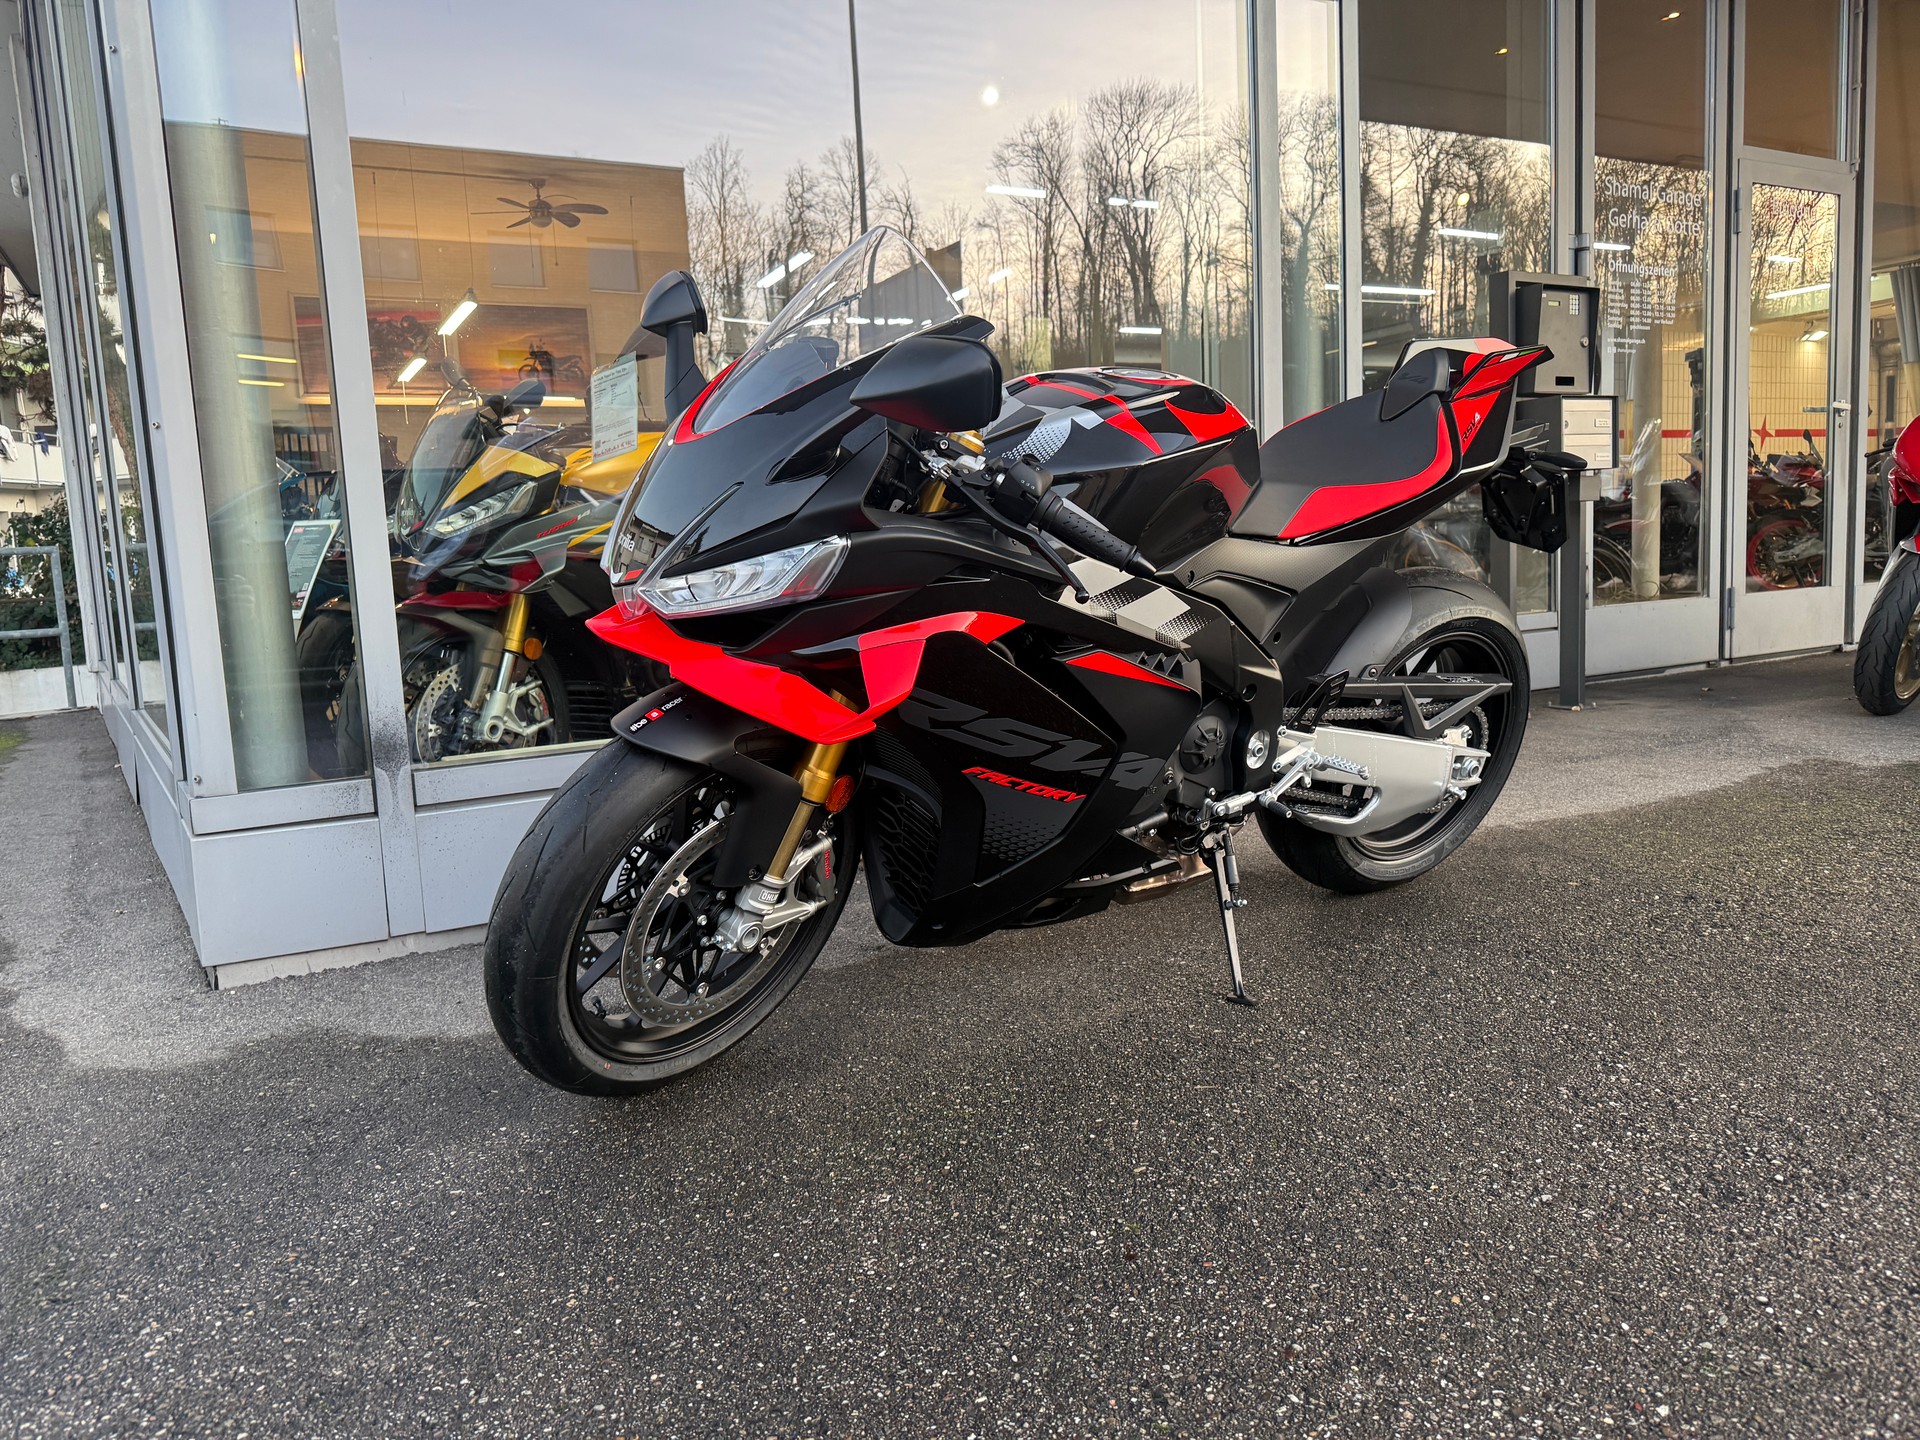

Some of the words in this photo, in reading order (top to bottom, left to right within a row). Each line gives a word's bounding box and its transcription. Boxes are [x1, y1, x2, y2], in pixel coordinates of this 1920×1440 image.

[1604, 174, 1655, 201] Shamal
[1656, 184, 1702, 211] Garage
[1462, 411, 1481, 443] RSV4
[630, 719, 647, 732] #be
[661, 697, 683, 711] racer
[898, 686, 1167, 791] RSV4
[961, 766, 1088, 804] FACTORY
